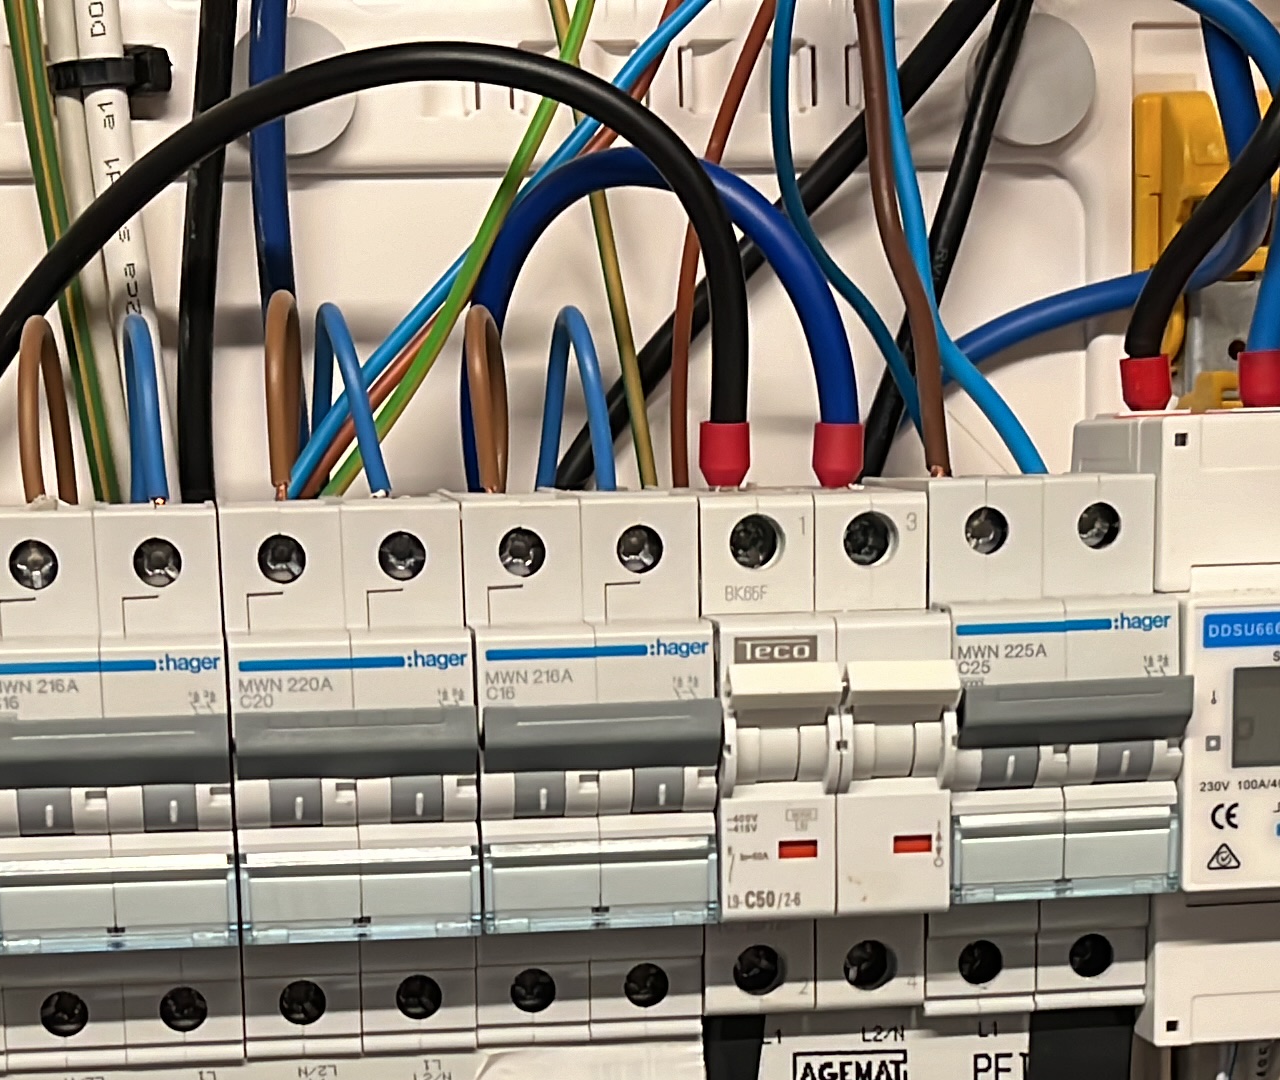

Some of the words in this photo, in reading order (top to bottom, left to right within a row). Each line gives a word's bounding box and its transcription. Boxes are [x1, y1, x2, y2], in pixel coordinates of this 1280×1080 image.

[906, 512, 918, 531] 3
[738, 639, 810, 661] Teco
[957, 645, 1000, 660] MWN
[1004, 643, 1048, 658] 225A
[958, 660, 991, 674] C25
[36, 678, 79, 694] 216A
[238, 678, 283, 694] MWN
[287, 677, 333, 693] 220A
[486, 686, 516, 701] C16
[240, 694, 274, 709] C20
[1199, 781, 1230, 792] 230V
